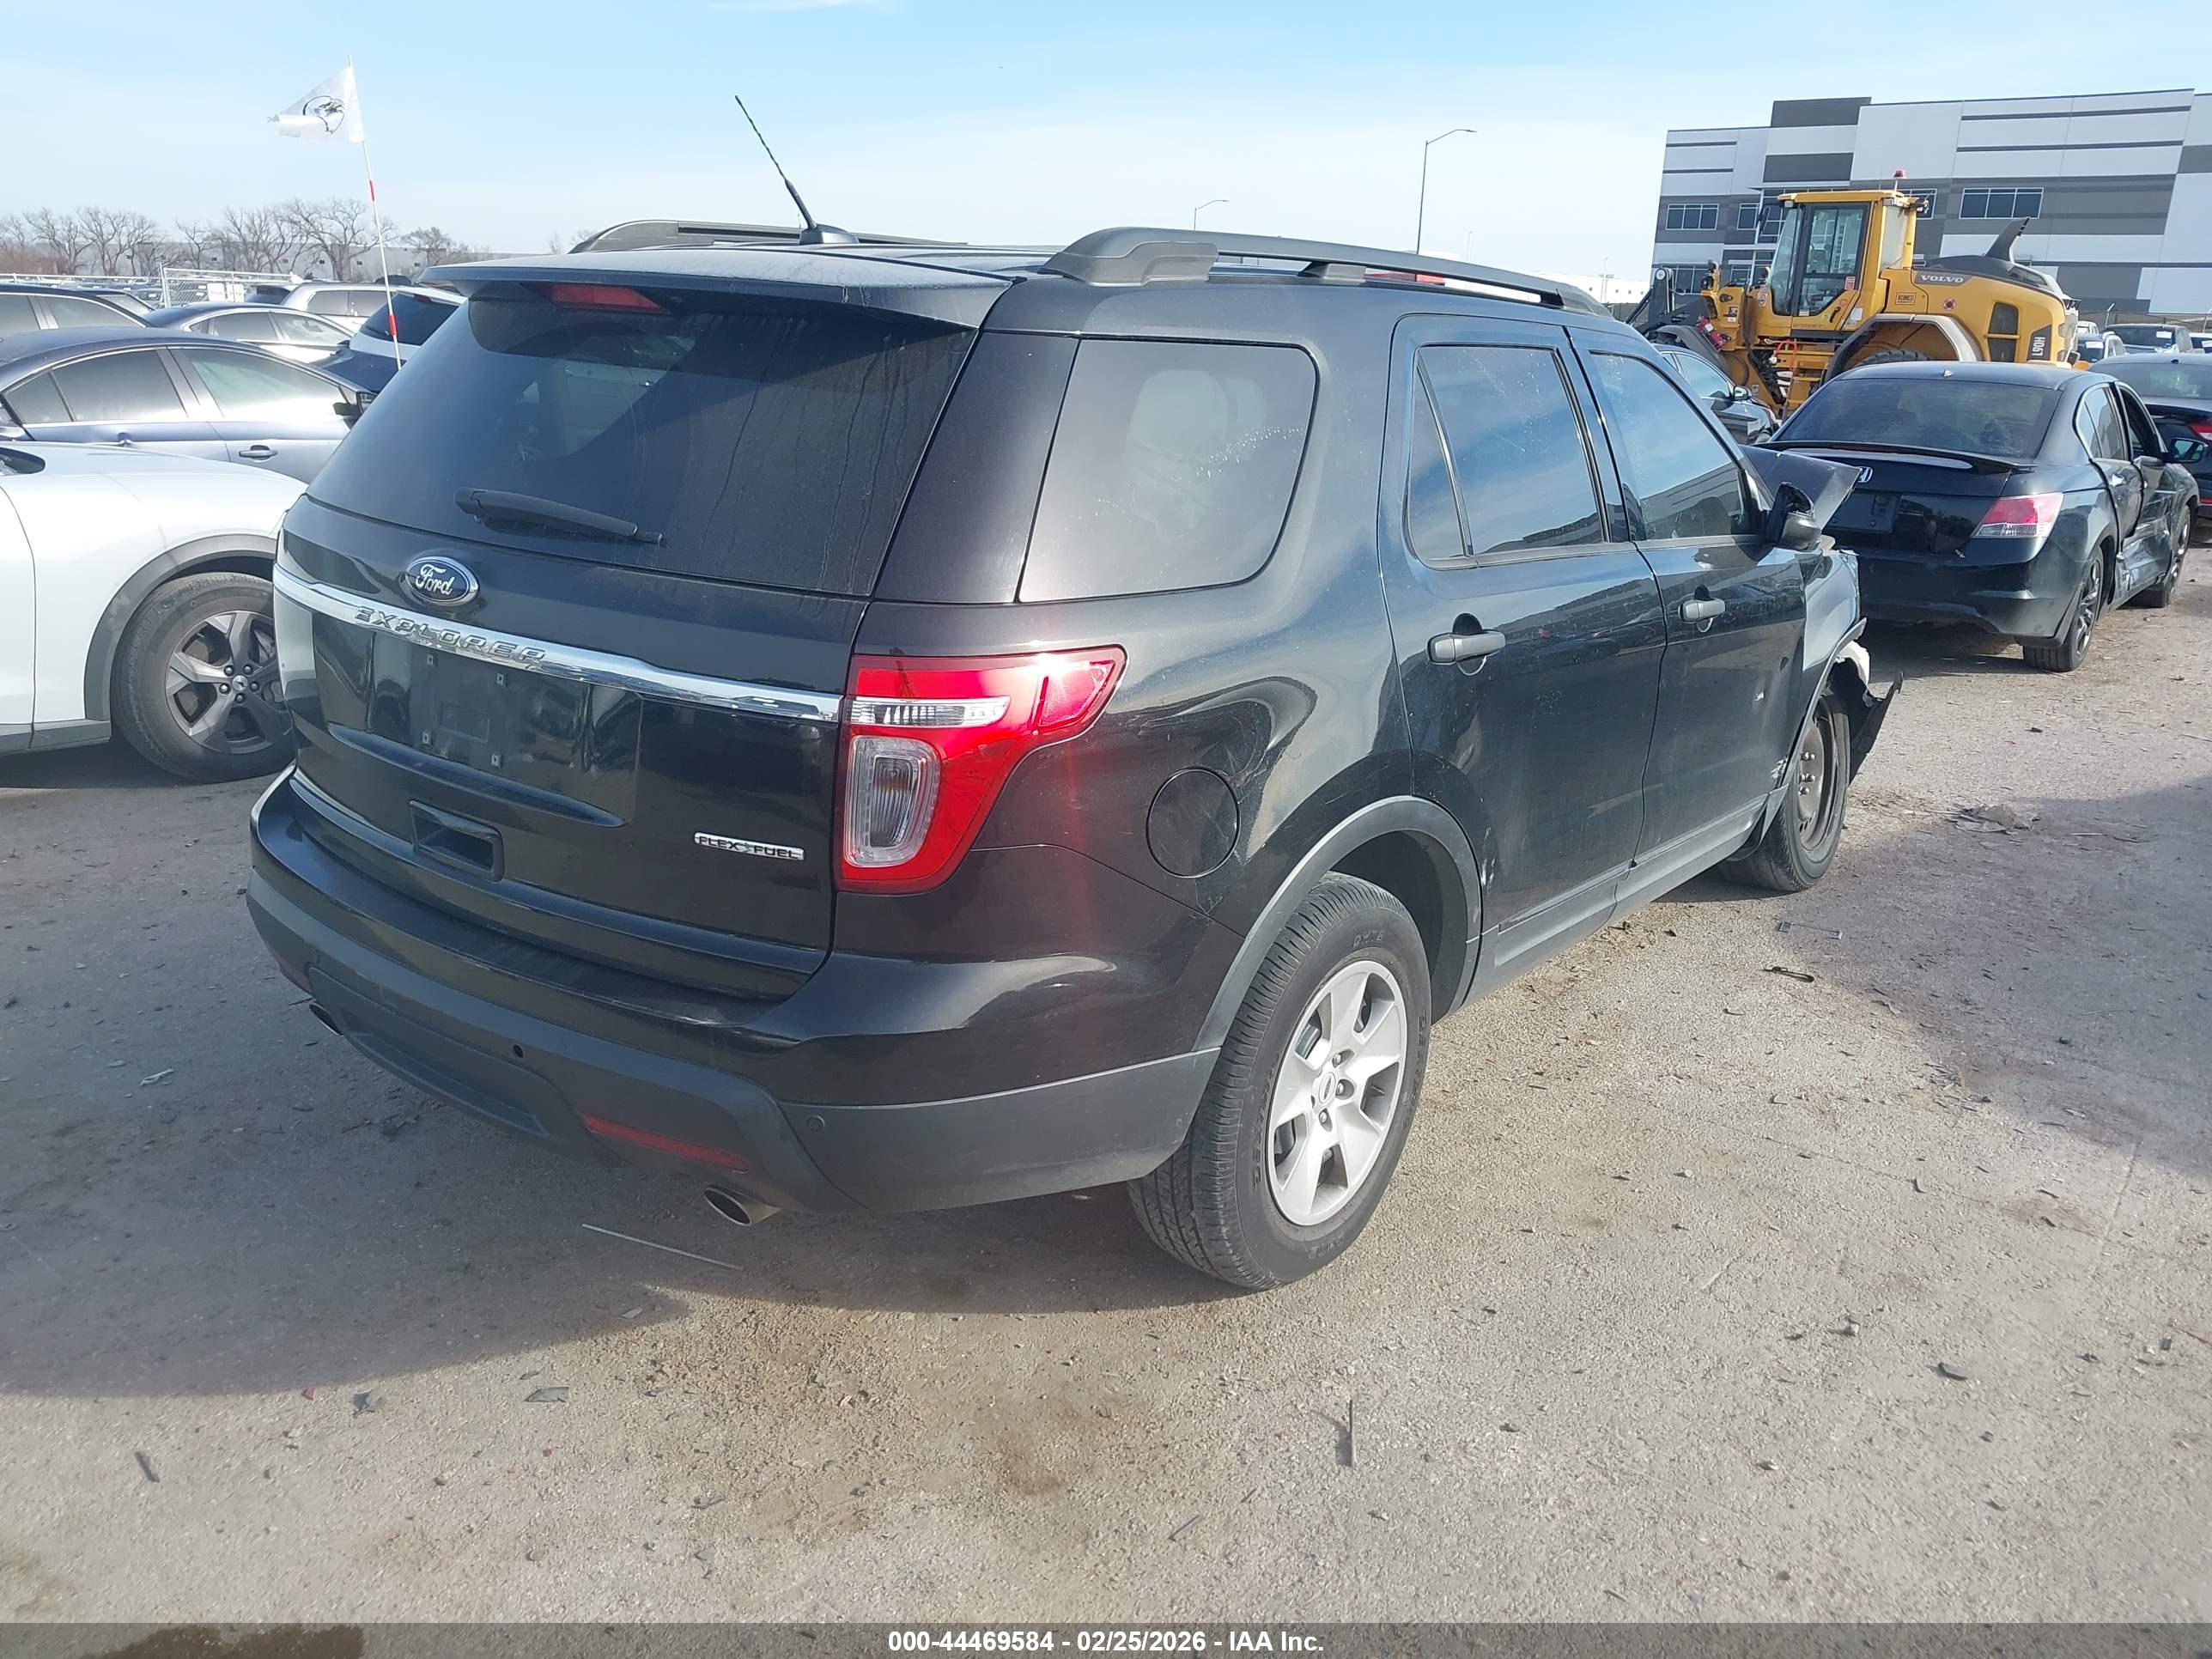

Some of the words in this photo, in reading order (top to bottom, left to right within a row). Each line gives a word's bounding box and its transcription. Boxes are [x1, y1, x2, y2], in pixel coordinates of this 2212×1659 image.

[1920, 275, 1965, 283] VOLVO
[2031, 336, 2046, 356] L90H
[415, 563, 455, 596] Ford
[355, 605, 546, 664] EXPLORER
[753, 844, 802, 860] FUEL
